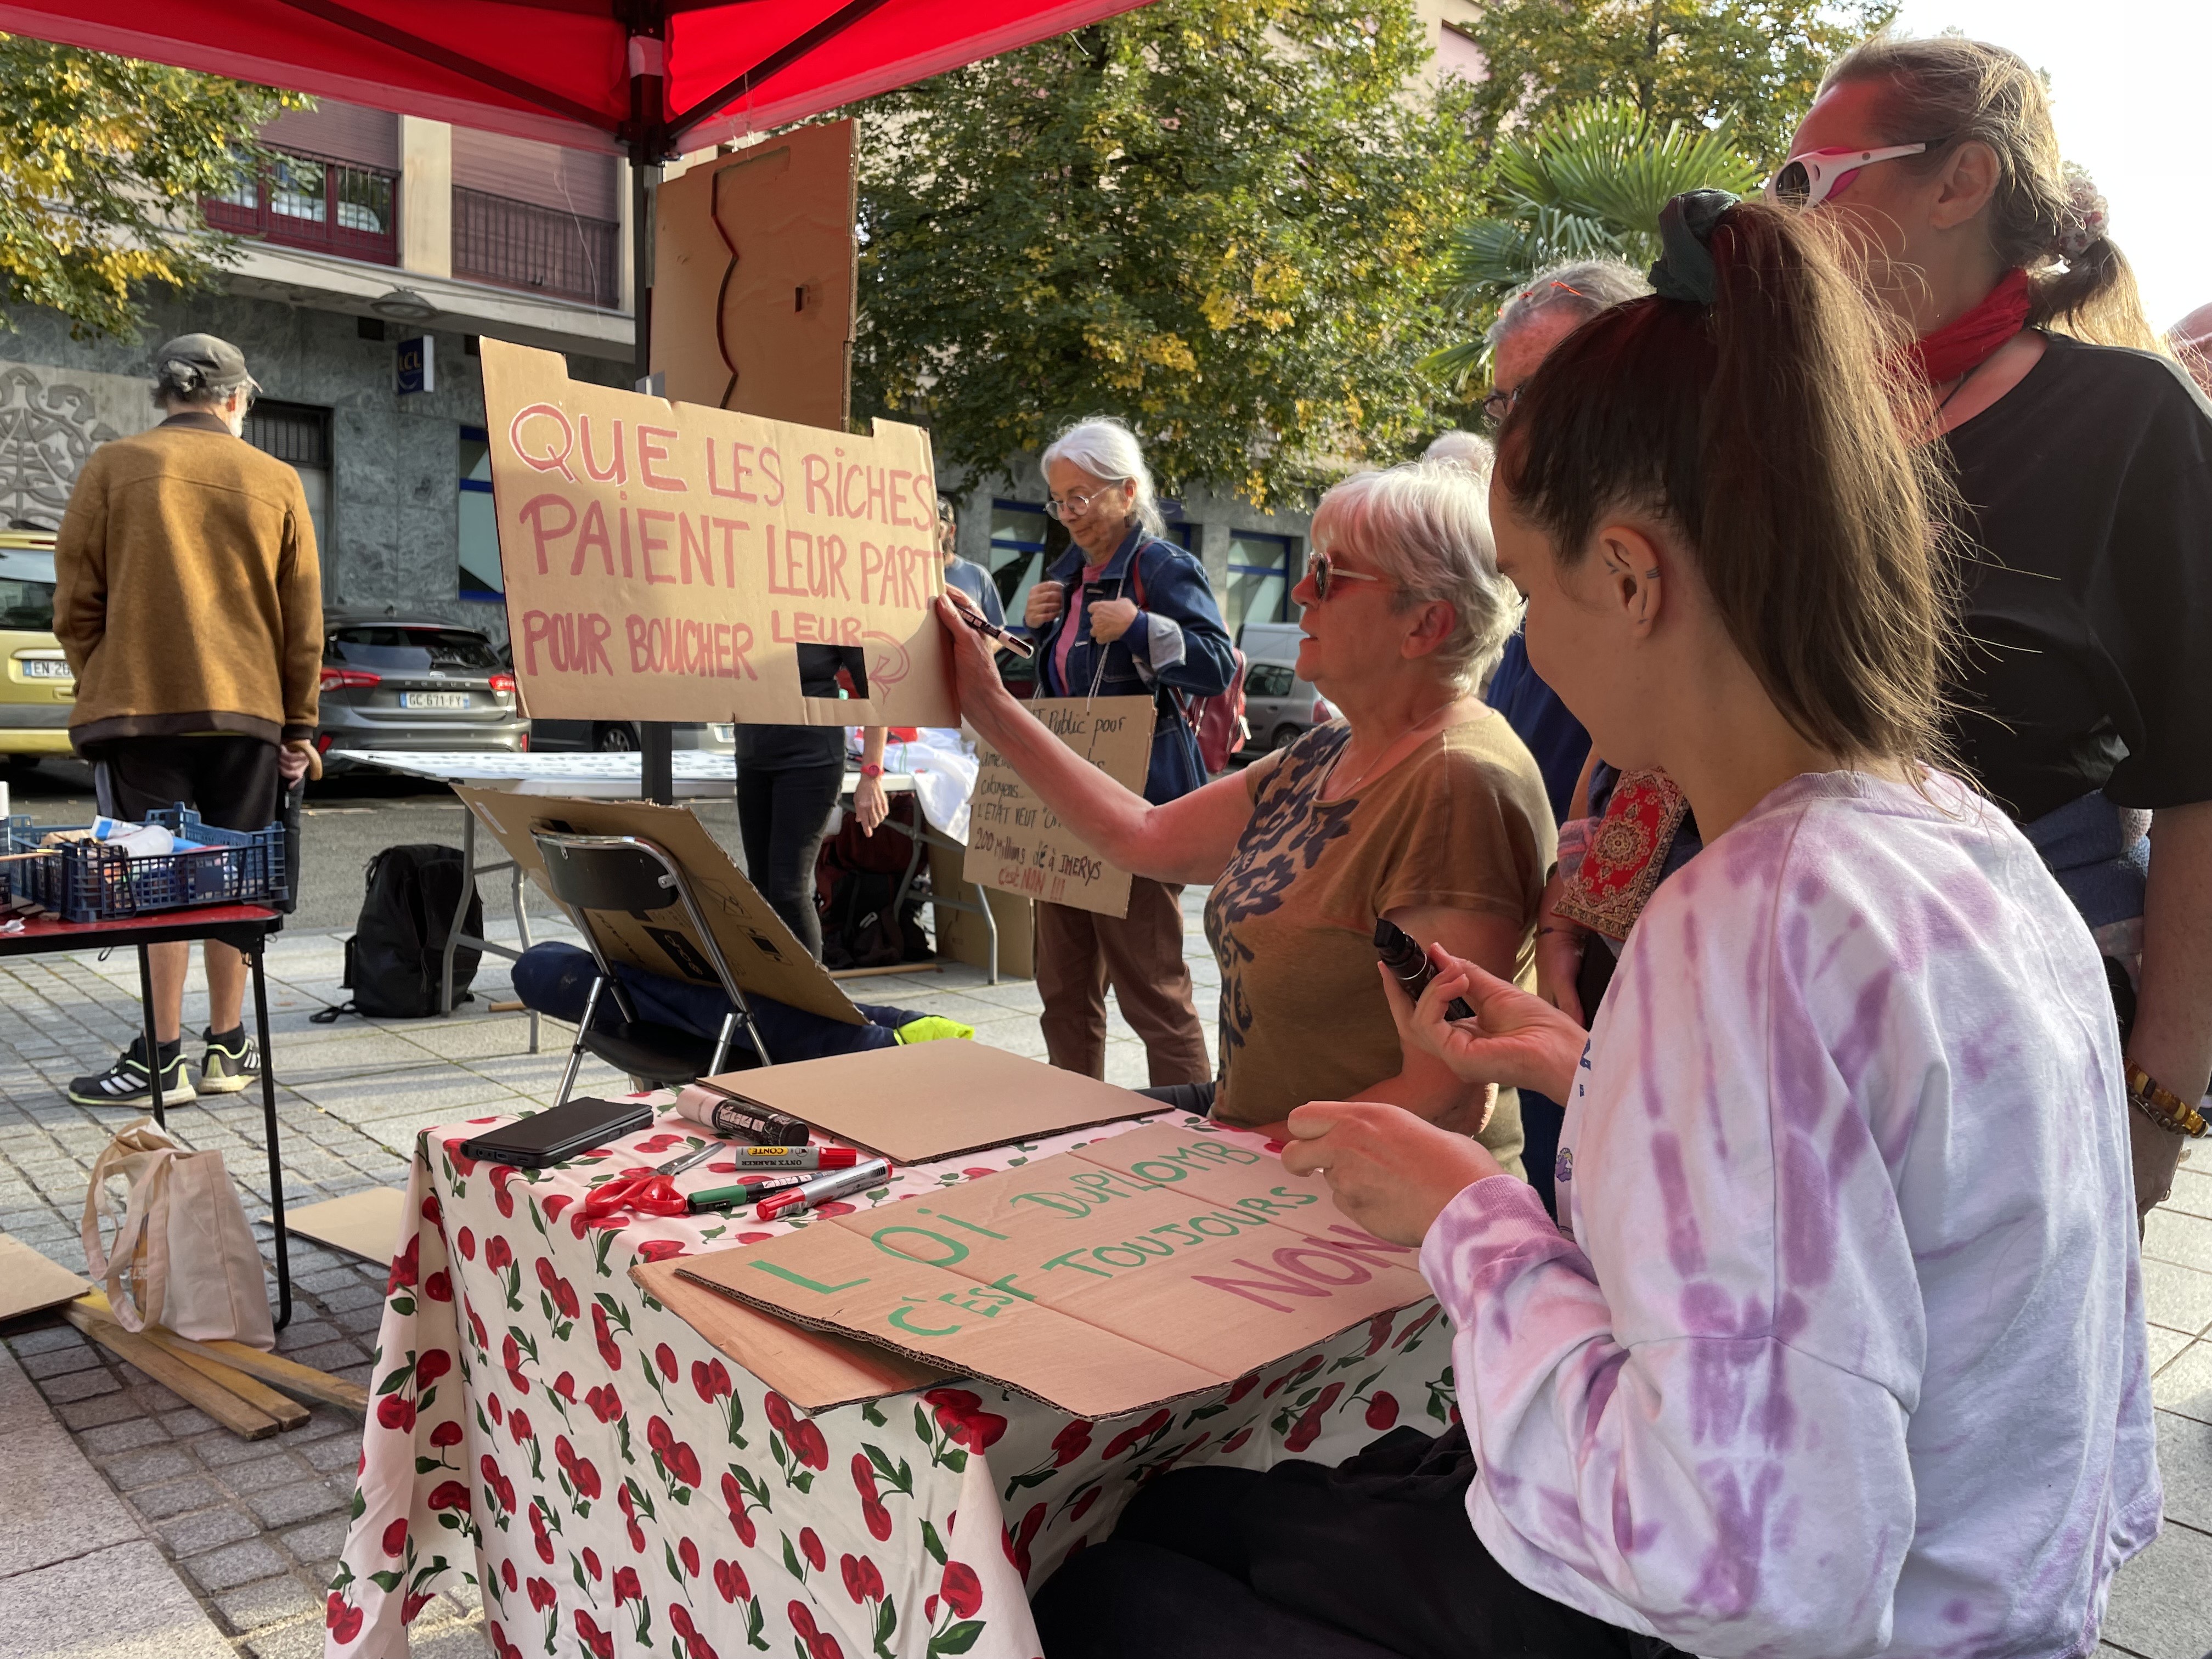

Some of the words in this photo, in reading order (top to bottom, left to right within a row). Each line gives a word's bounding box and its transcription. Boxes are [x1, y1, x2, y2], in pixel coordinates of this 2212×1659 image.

[398, 351, 421, 371] LCL
[510, 403, 687, 492] QUE
[706, 436, 784, 507] LES
[766, 524, 850, 601] LEUR
[861, 541, 943, 611] PART
[523, 610, 613, 676] POUR
[625, 614, 759, 681] BOUCHER
[772, 611, 863, 647] LEUR
[975, 827, 994, 851] 200
[1058, 854, 1102, 886] IMERYS
[1020, 867, 1046, 895] NON
[888, 1274, 1037, 1336] C'EST
[1040, 1187, 1318, 1278] TOUJOURS
[1190, 1224, 1413, 1313] NON
